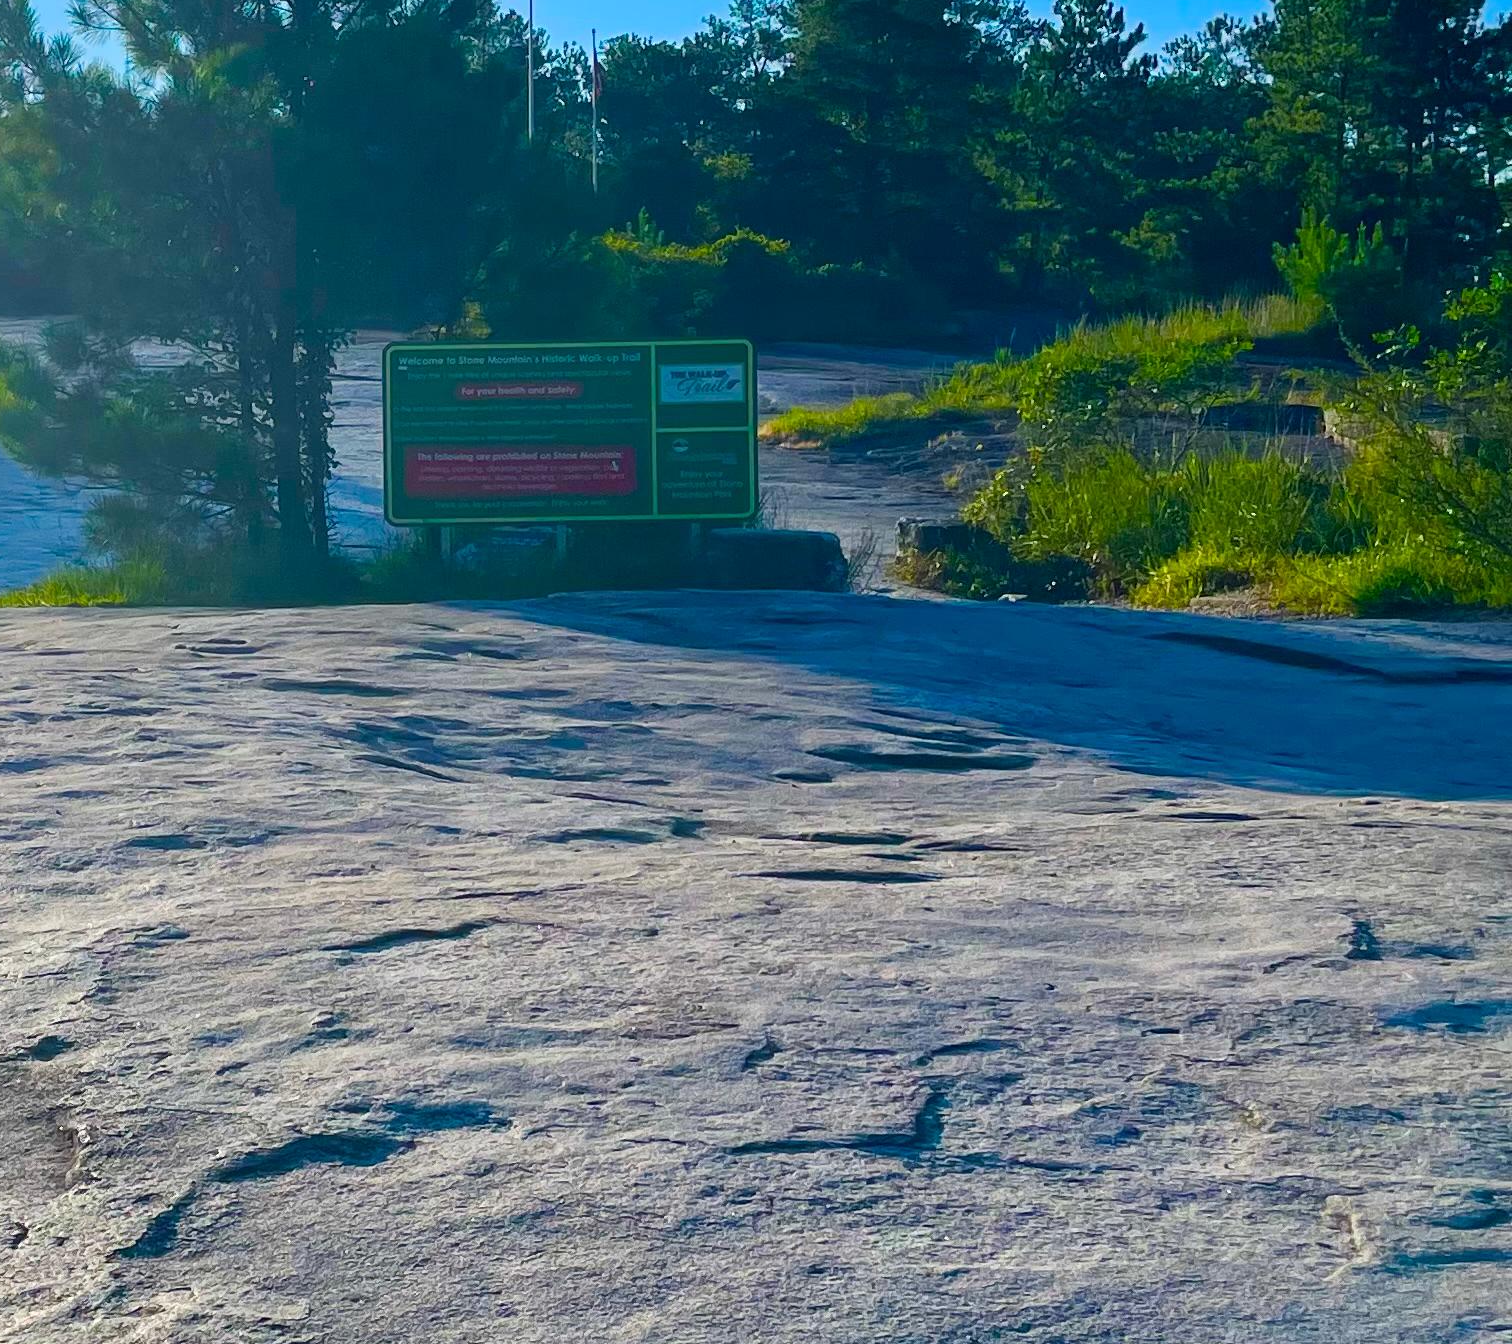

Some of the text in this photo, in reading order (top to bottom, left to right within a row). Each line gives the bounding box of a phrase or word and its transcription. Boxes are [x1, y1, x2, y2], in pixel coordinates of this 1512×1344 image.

[399, 356, 443, 365] Welcome
[446, 356, 456, 365] to
[458, 355, 485, 365] Stone
[488, 355, 540, 364] Mountains
[542, 354, 576, 363] Historic
[621, 352, 641, 362] Trail
[688, 370, 728, 378] WALK-UP
[676, 374, 730, 396] Trail
[461, 387, 475, 395] For
[476, 388, 497, 397] your
[498, 386, 526, 395] health
[527, 386, 545, 395] and
[417, 453, 432, 462] The
[434, 452, 473, 463] following
[476, 454, 491, 462] are
[492, 452, 538, 463] prohibited
[539, 452, 552, 460] on
[553, 451, 578, 460] Stone
